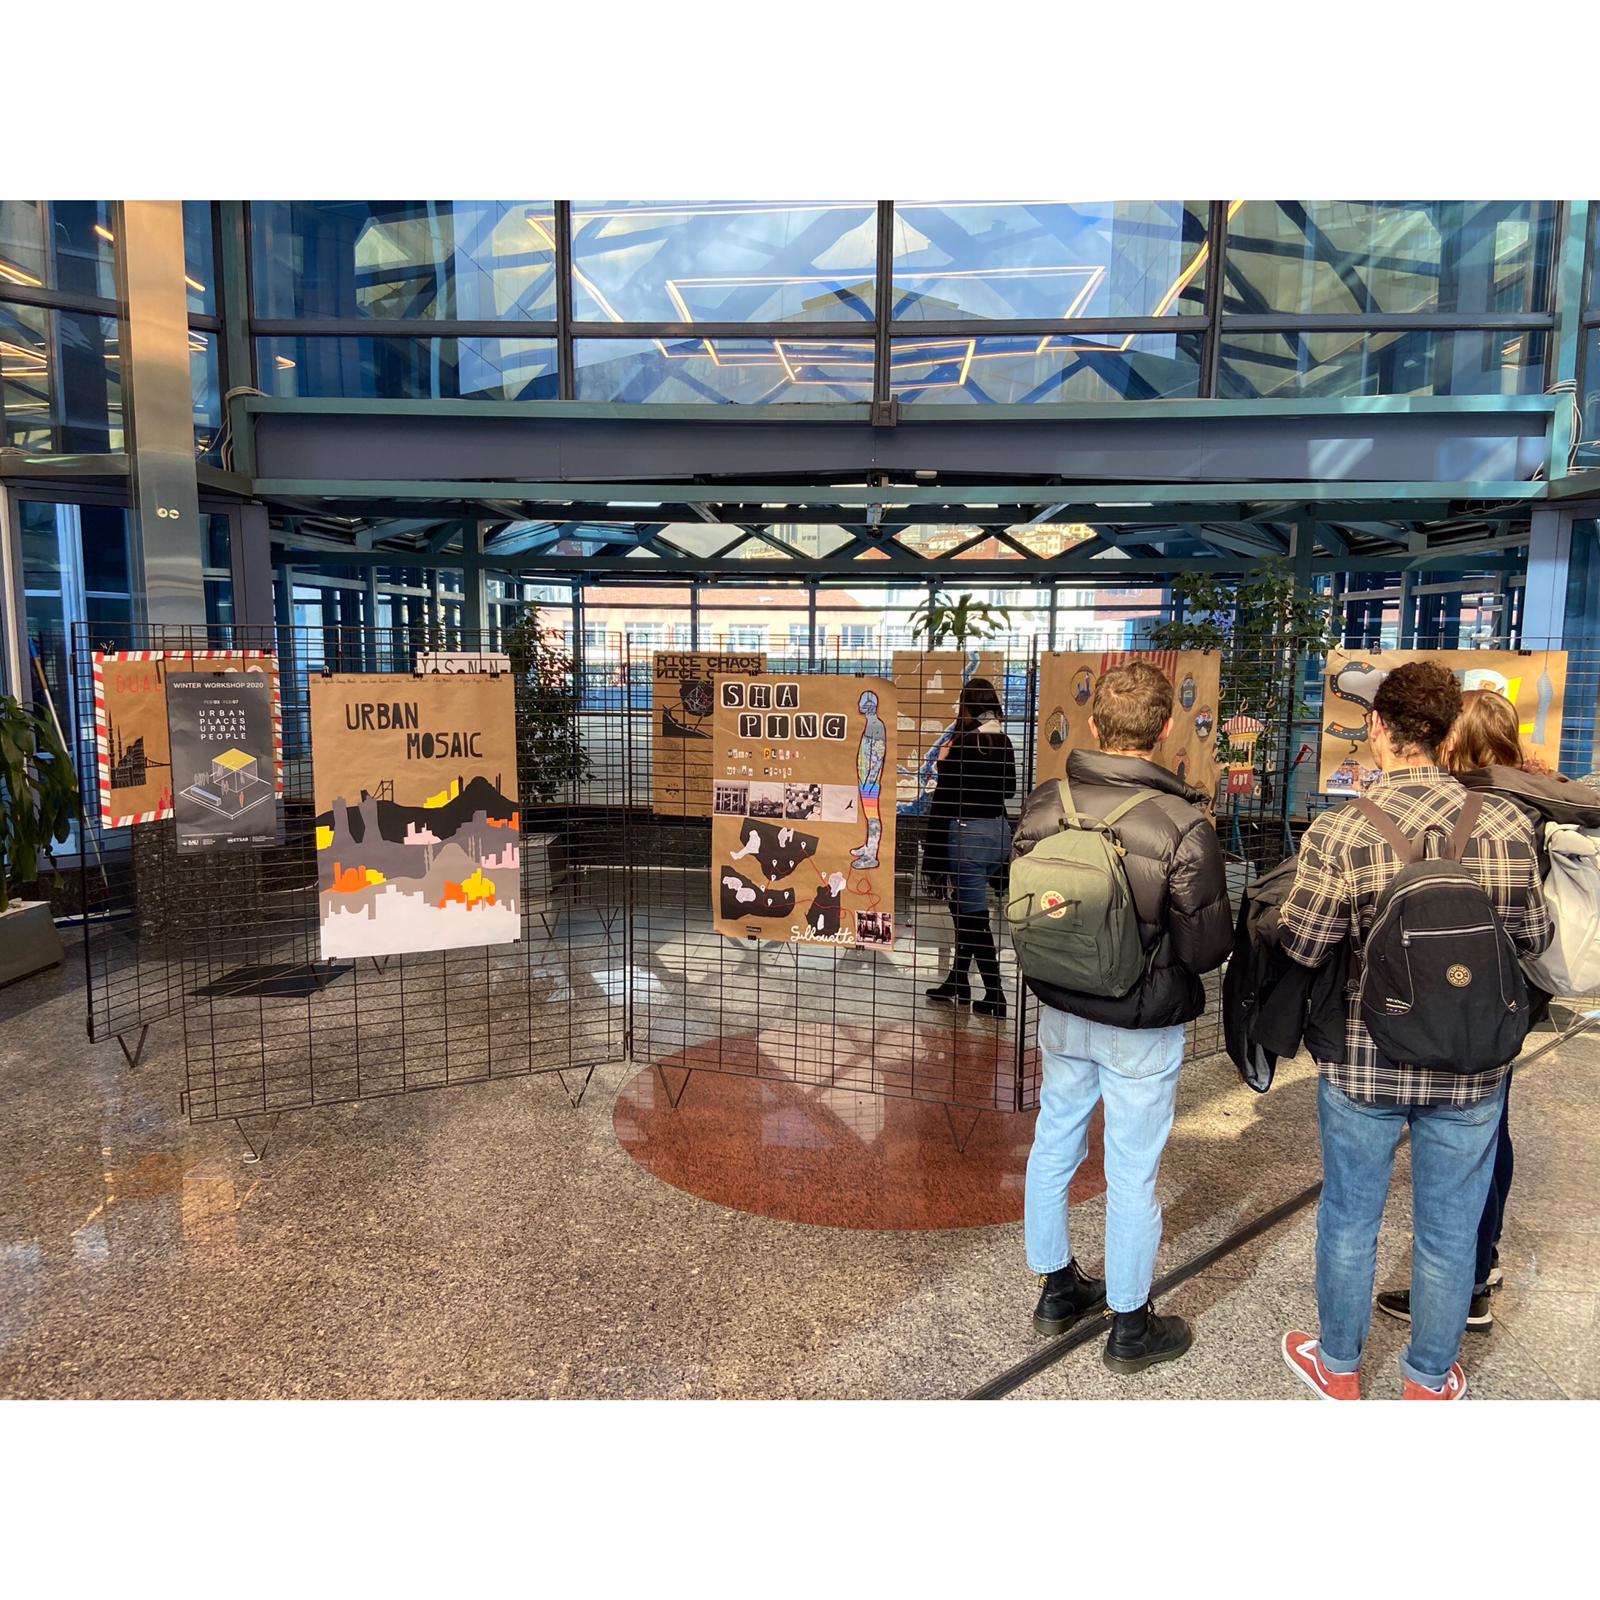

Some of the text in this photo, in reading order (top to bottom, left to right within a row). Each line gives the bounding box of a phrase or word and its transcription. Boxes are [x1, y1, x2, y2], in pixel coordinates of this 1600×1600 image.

[657, 655, 762, 669] RICE CHAOS
[725, 684, 797, 708] SHA
[199, 709, 246, 717] URBAN
[200, 717, 246, 725] PLACES
[345, 702, 419, 730] URBAN
[200, 724, 246, 732] URBAN
[743, 714, 843, 738] PING
[200, 732, 247, 740] PEOPLE
[406, 732, 483, 760] MOSAIC
[790, 924, 856, 944] Silhouette
